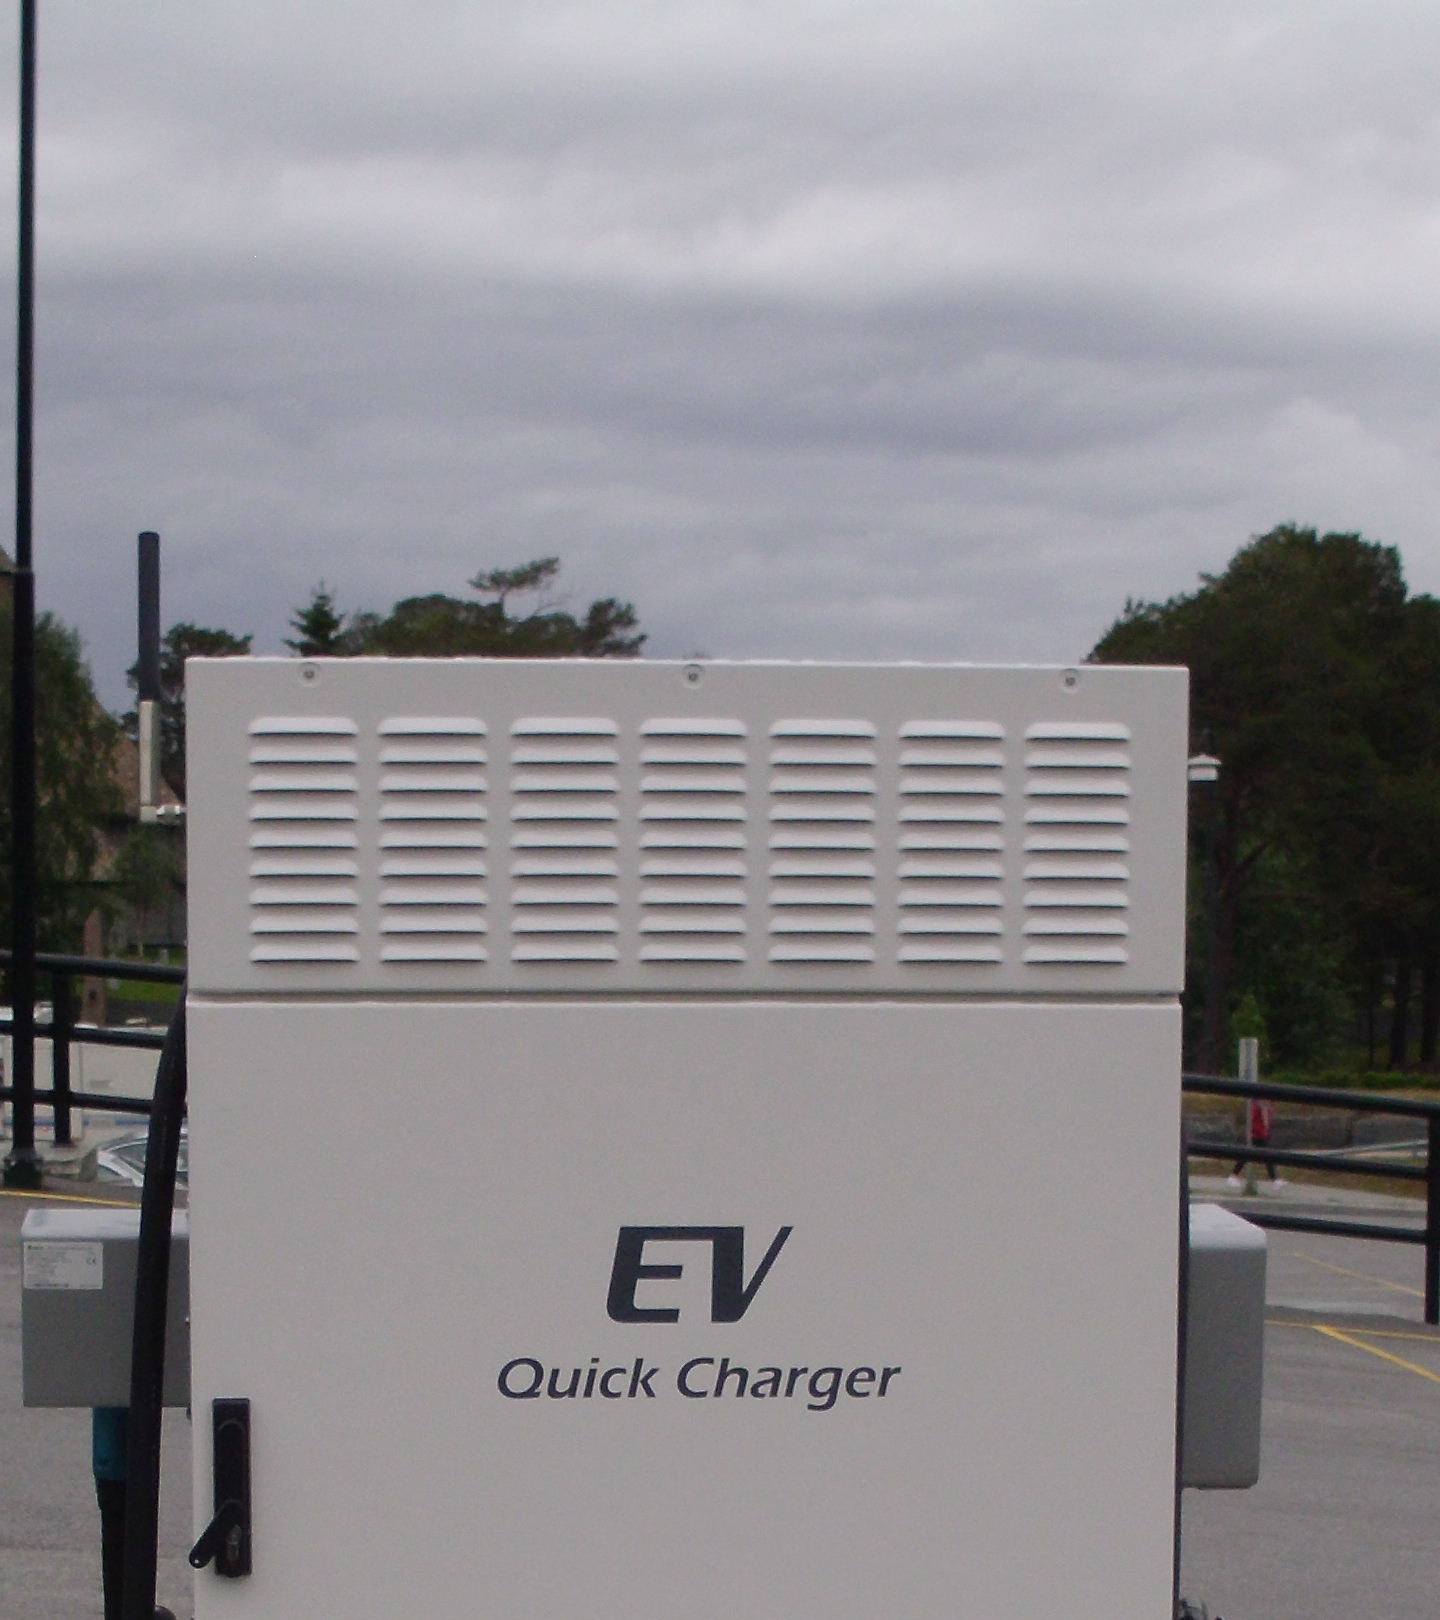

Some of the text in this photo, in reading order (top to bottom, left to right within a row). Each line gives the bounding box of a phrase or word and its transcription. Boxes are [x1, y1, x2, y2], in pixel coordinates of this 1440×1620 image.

[606, 1225, 794, 1324] EV
[497, 1357, 902, 1412] Quick Charger
